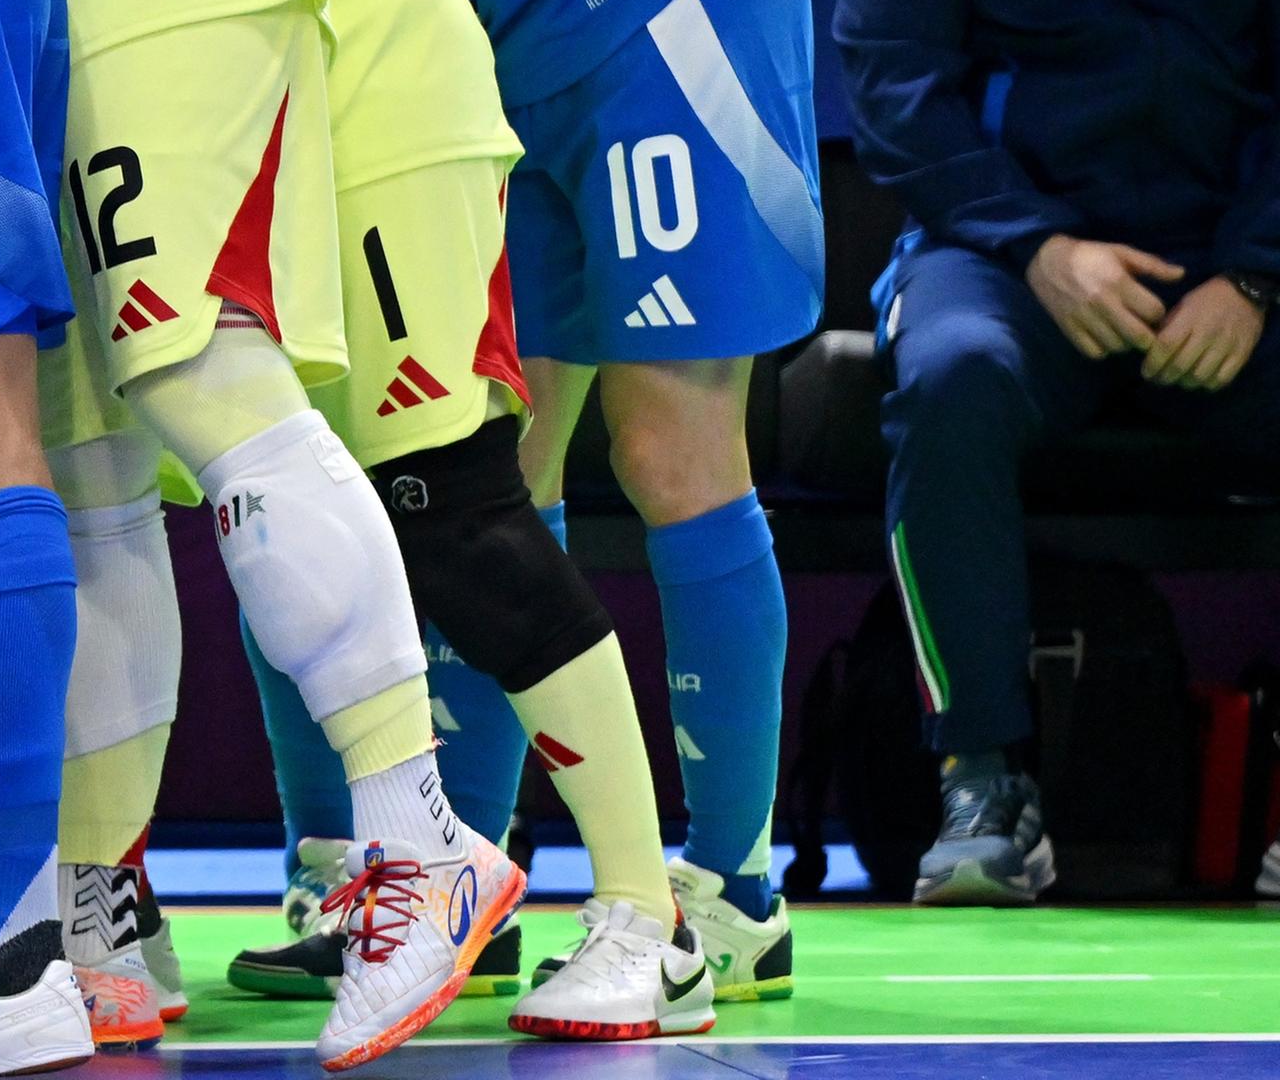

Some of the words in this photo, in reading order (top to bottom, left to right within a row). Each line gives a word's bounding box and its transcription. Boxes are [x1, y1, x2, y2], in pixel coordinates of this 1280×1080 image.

[68, 145, 158, 275] 12
[606, 134, 699, 259] 10
[362, 226, 408, 342] 1
